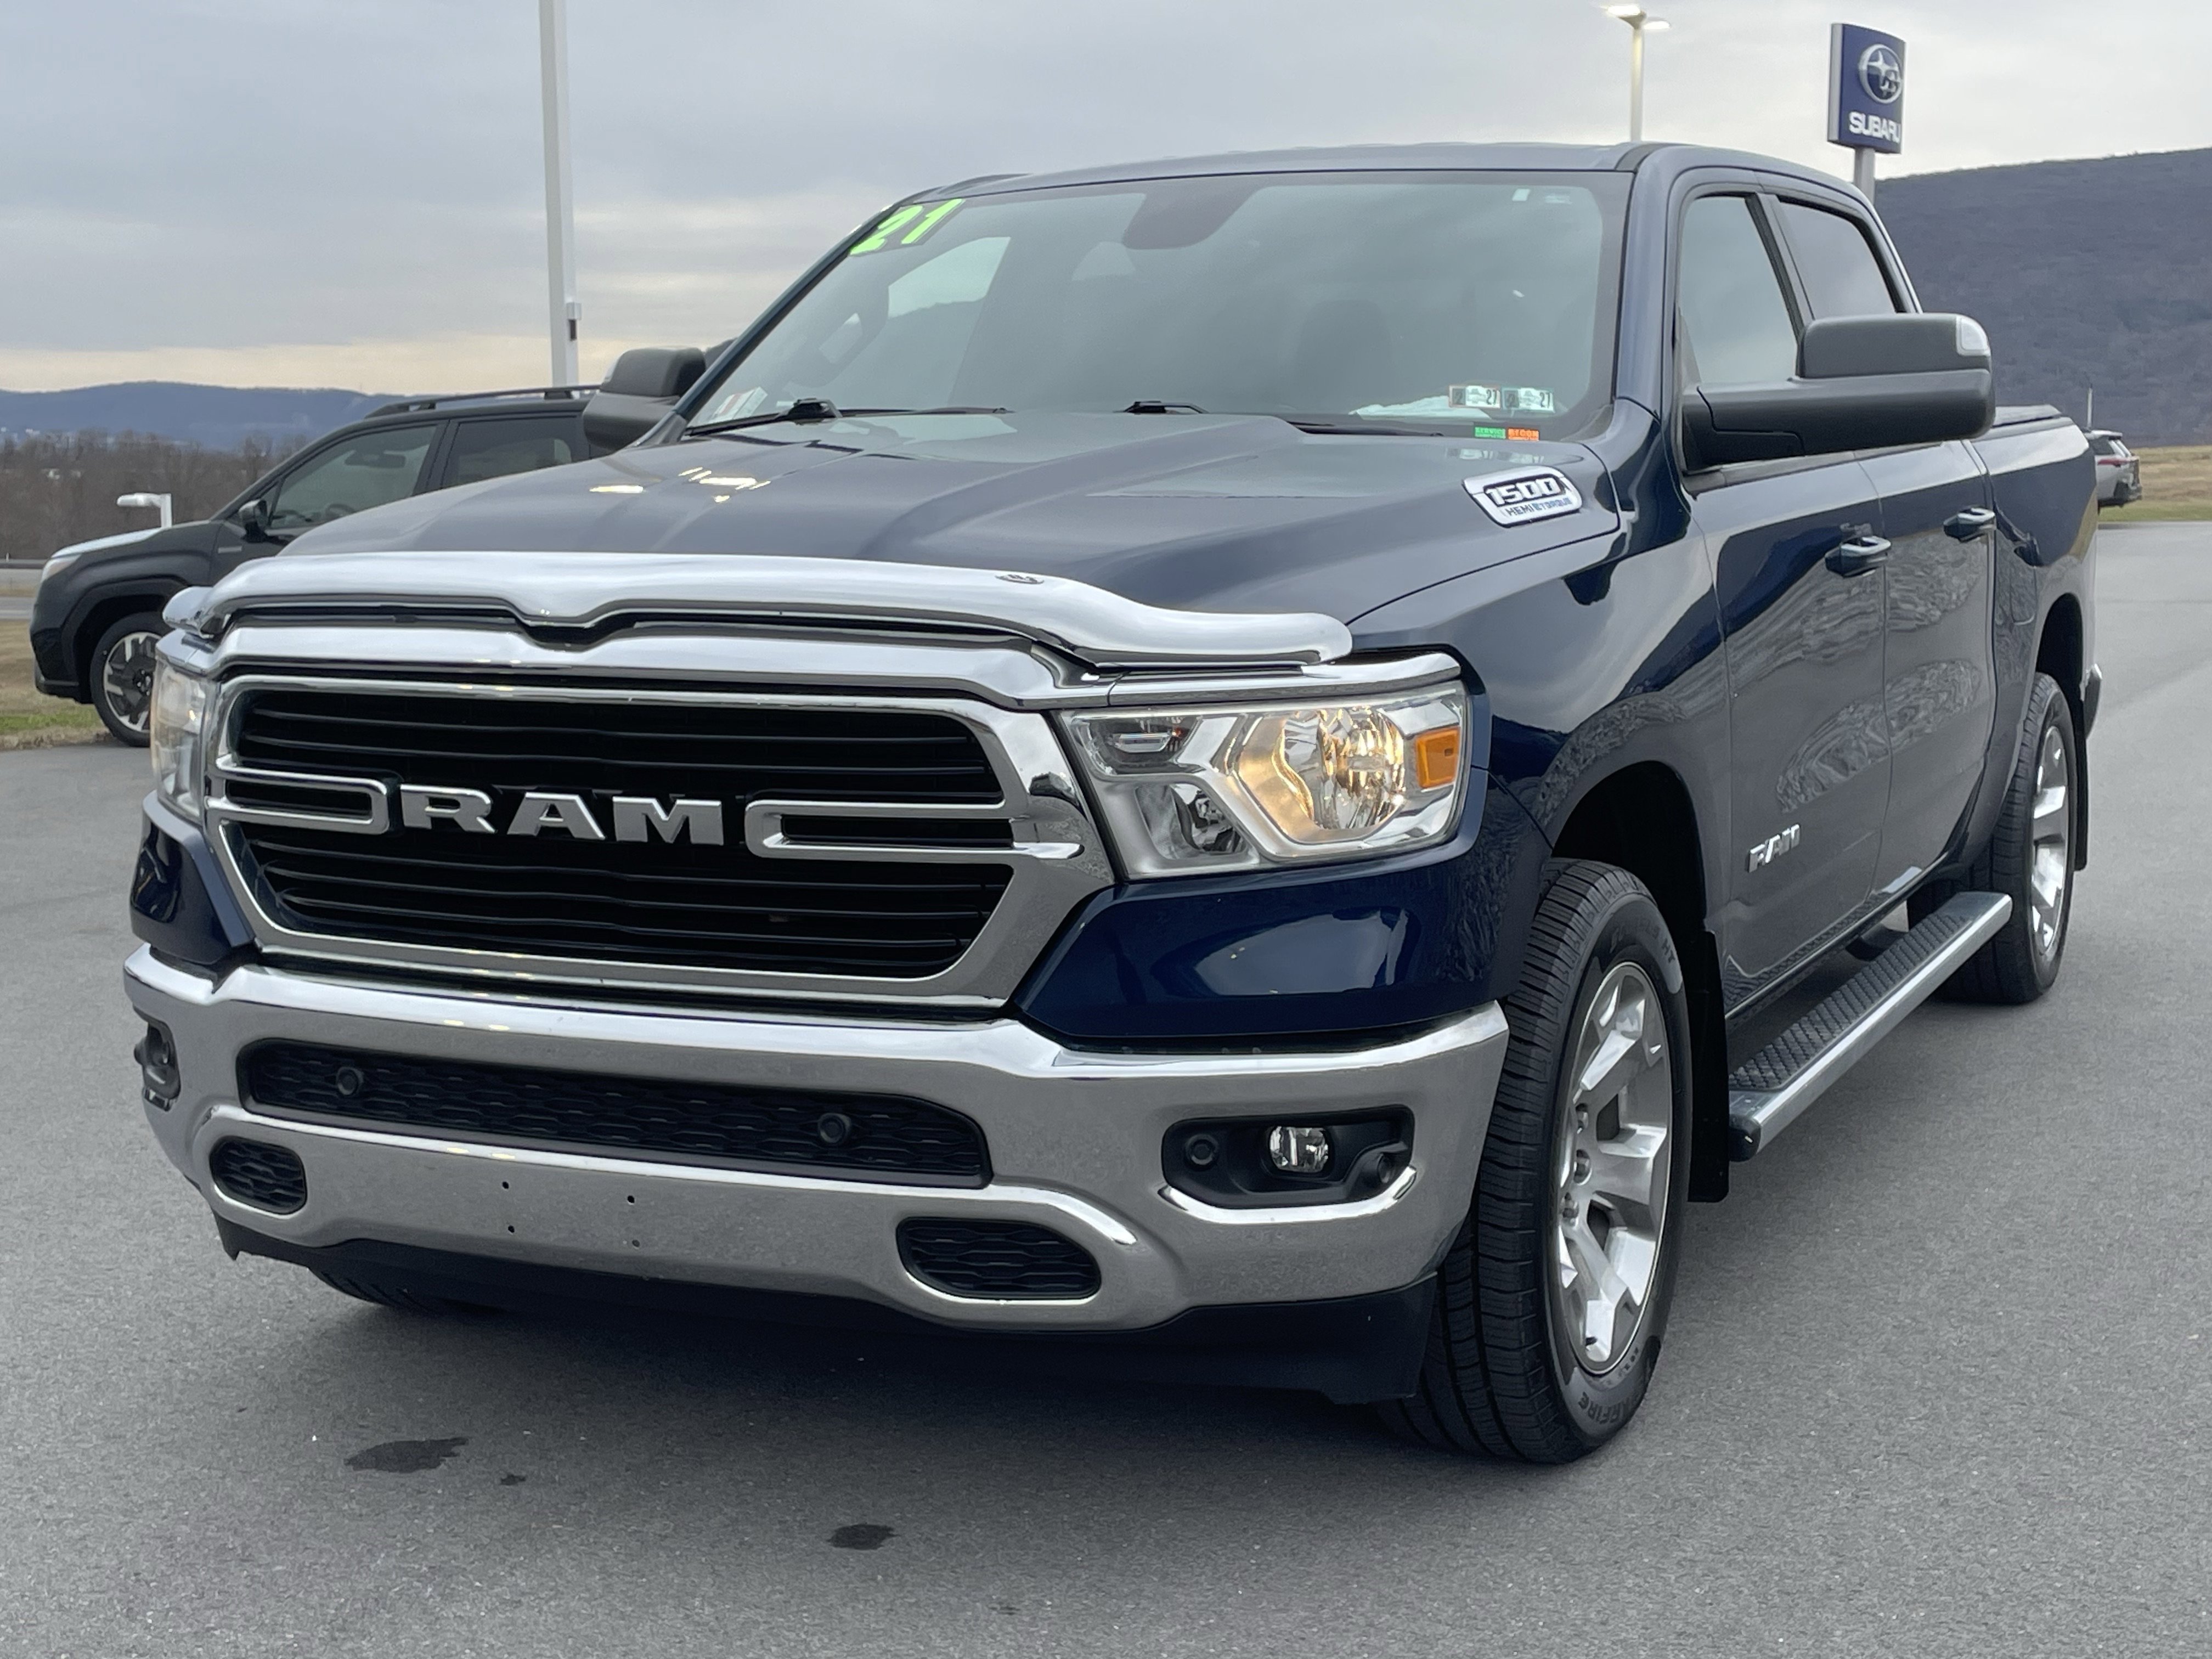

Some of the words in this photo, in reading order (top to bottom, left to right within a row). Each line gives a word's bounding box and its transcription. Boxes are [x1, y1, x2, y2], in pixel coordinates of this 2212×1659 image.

[1849, 111, 1901, 143] SUBARU
[849, 198, 965, 255] 21
[1486, 389, 1497, 405] 27
[1539, 392, 1550, 408] 27
[1485, 477, 1561, 505] 1500
[1504, 503, 1535, 516] HEMI
[399, 783, 724, 846] RAM
[1748, 824, 1800, 873] RAM
